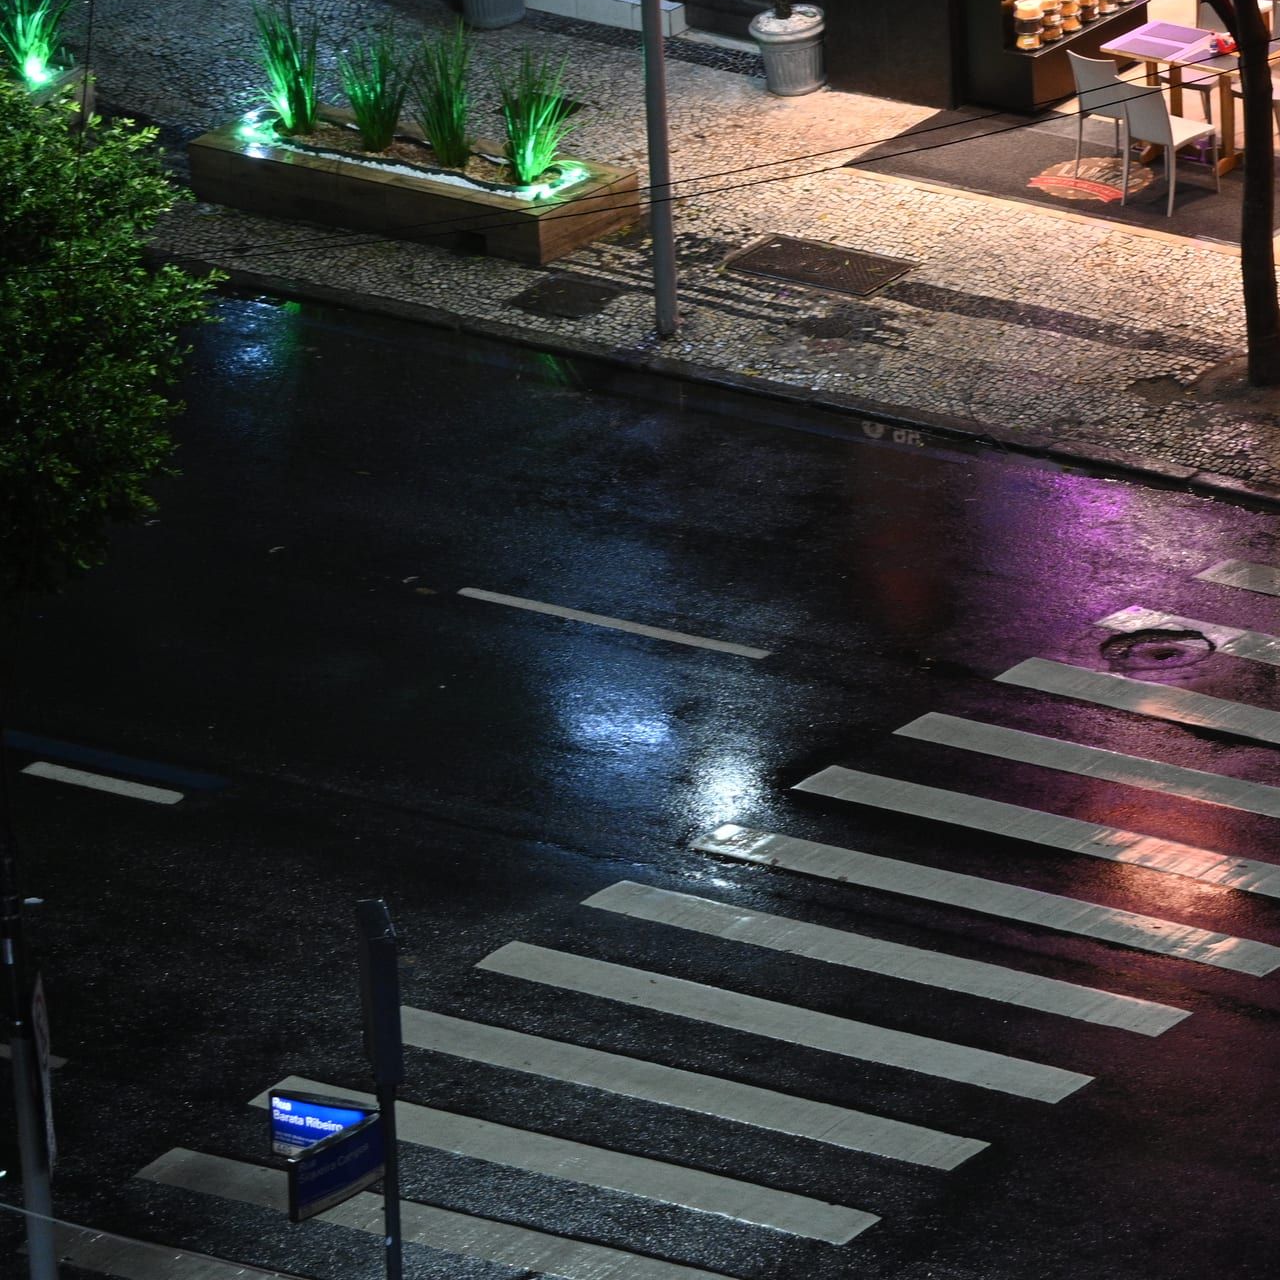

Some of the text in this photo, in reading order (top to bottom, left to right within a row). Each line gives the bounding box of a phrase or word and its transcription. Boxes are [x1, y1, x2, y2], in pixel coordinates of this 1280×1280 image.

[272, 1097, 292, 1111] Rua
[273, 1109, 344, 1132] Barata Ribeiro
